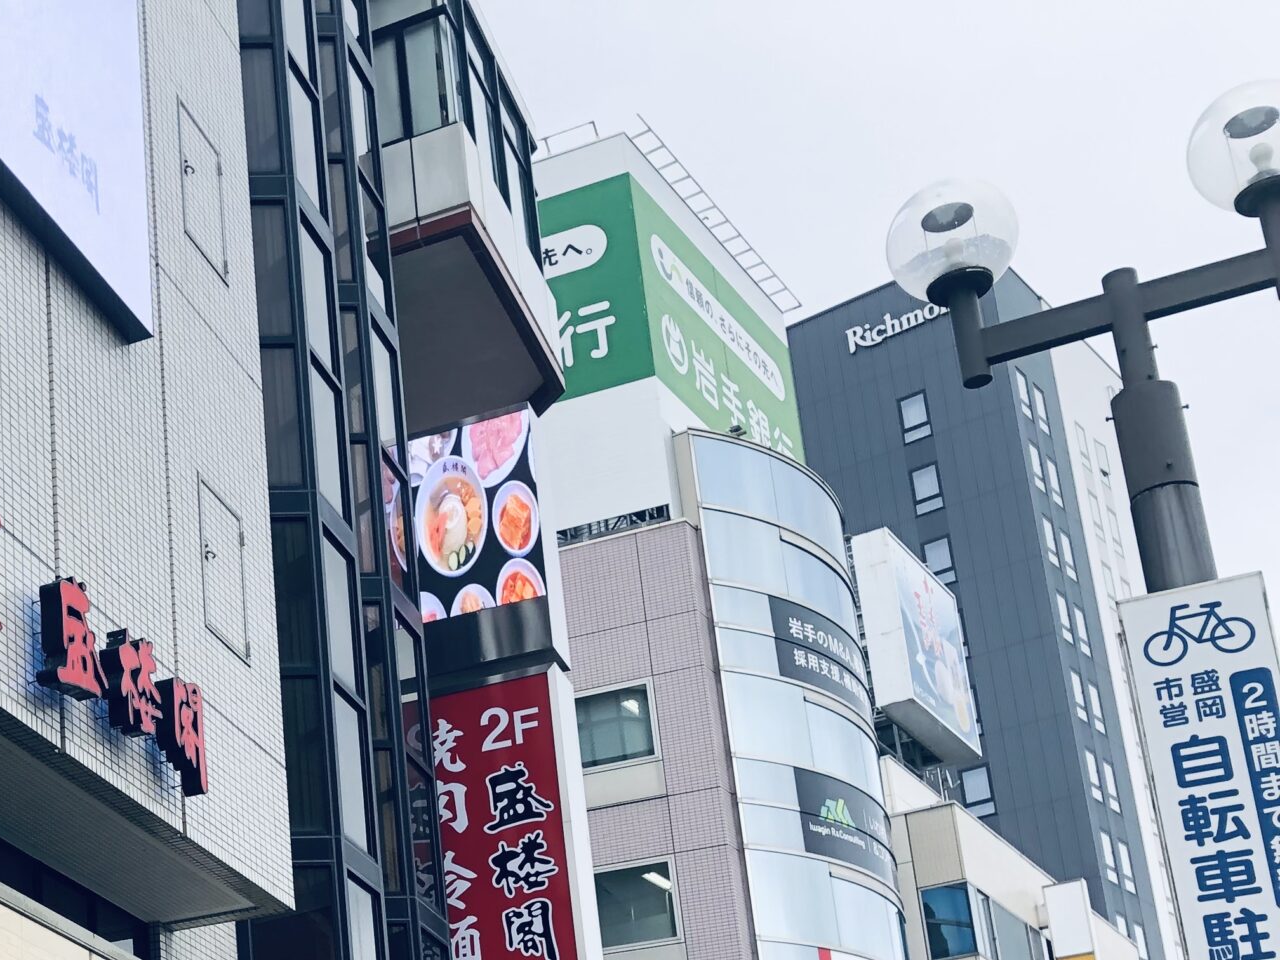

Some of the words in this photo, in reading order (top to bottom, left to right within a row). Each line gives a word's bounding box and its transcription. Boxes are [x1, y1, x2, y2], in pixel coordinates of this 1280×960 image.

[845, 302, 951, 354] Richmo
[43, 576, 209, 797] 盛楼閣
[1153, 677, 1190, 728] 市営
[1190, 668, 1227, 722] 盛岡
[480, 706, 540, 752] 2F
[1241, 681, 1280, 890] 2時間まで
